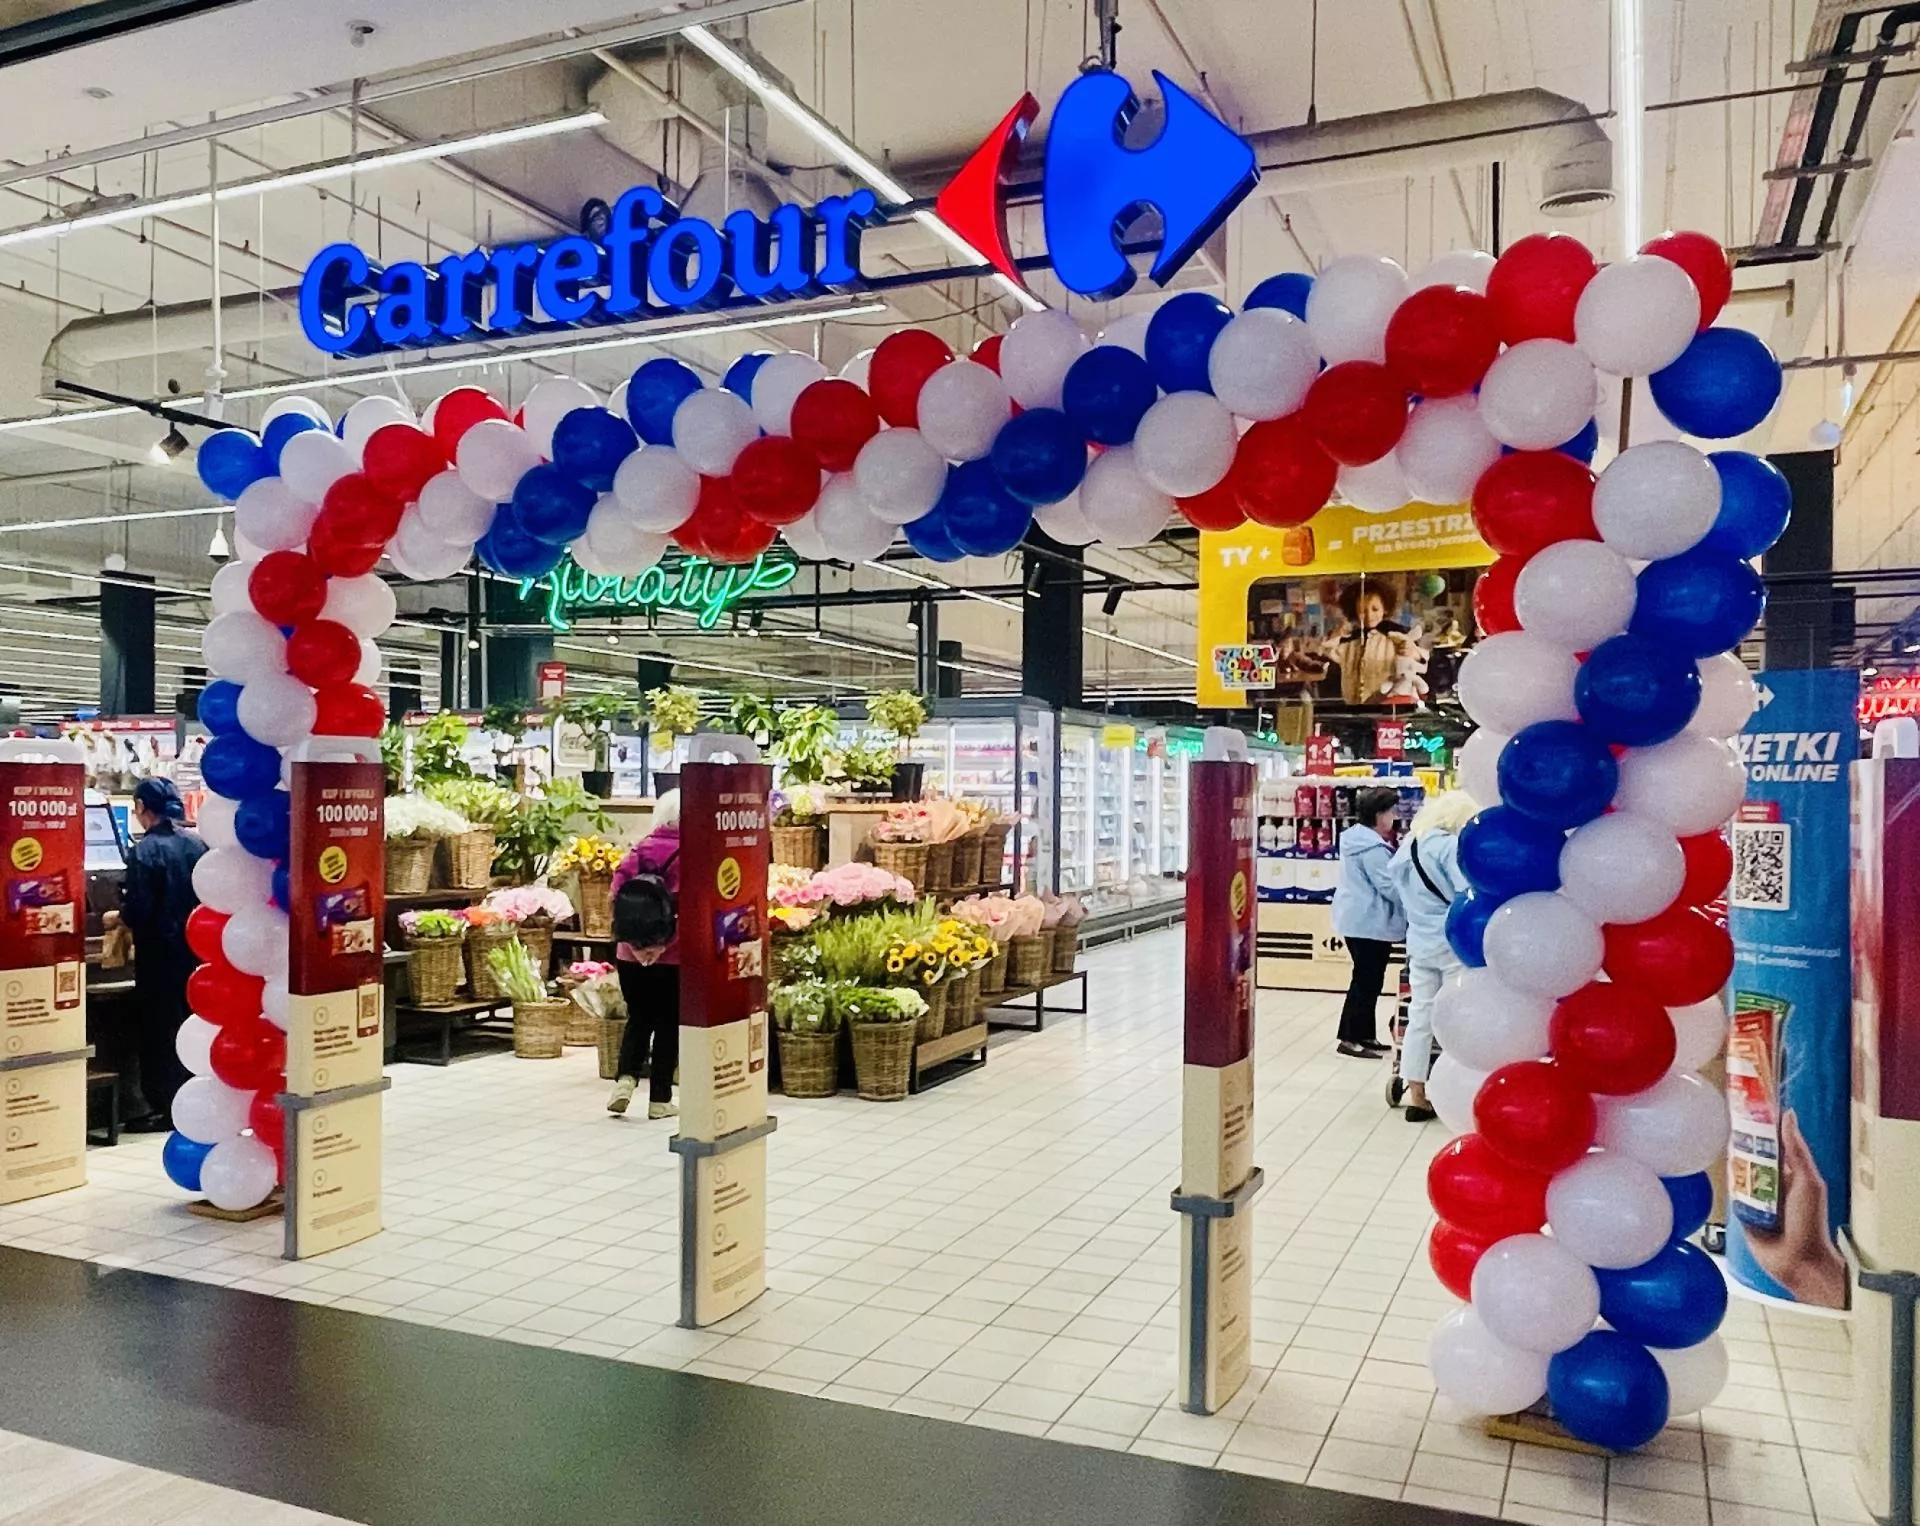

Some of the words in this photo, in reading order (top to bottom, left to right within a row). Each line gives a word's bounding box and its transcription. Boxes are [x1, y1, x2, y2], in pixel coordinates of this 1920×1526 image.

[298, 186, 878, 356] Carrefour
[1219, 545, 1253, 568] TY
[1223, 669, 1273, 683] SEZON
[1751, 764, 1840, 782] ONLINE
[8, 800, 38, 817] 100
[316, 804, 343, 823] 100
[715, 810, 737, 831] 100
